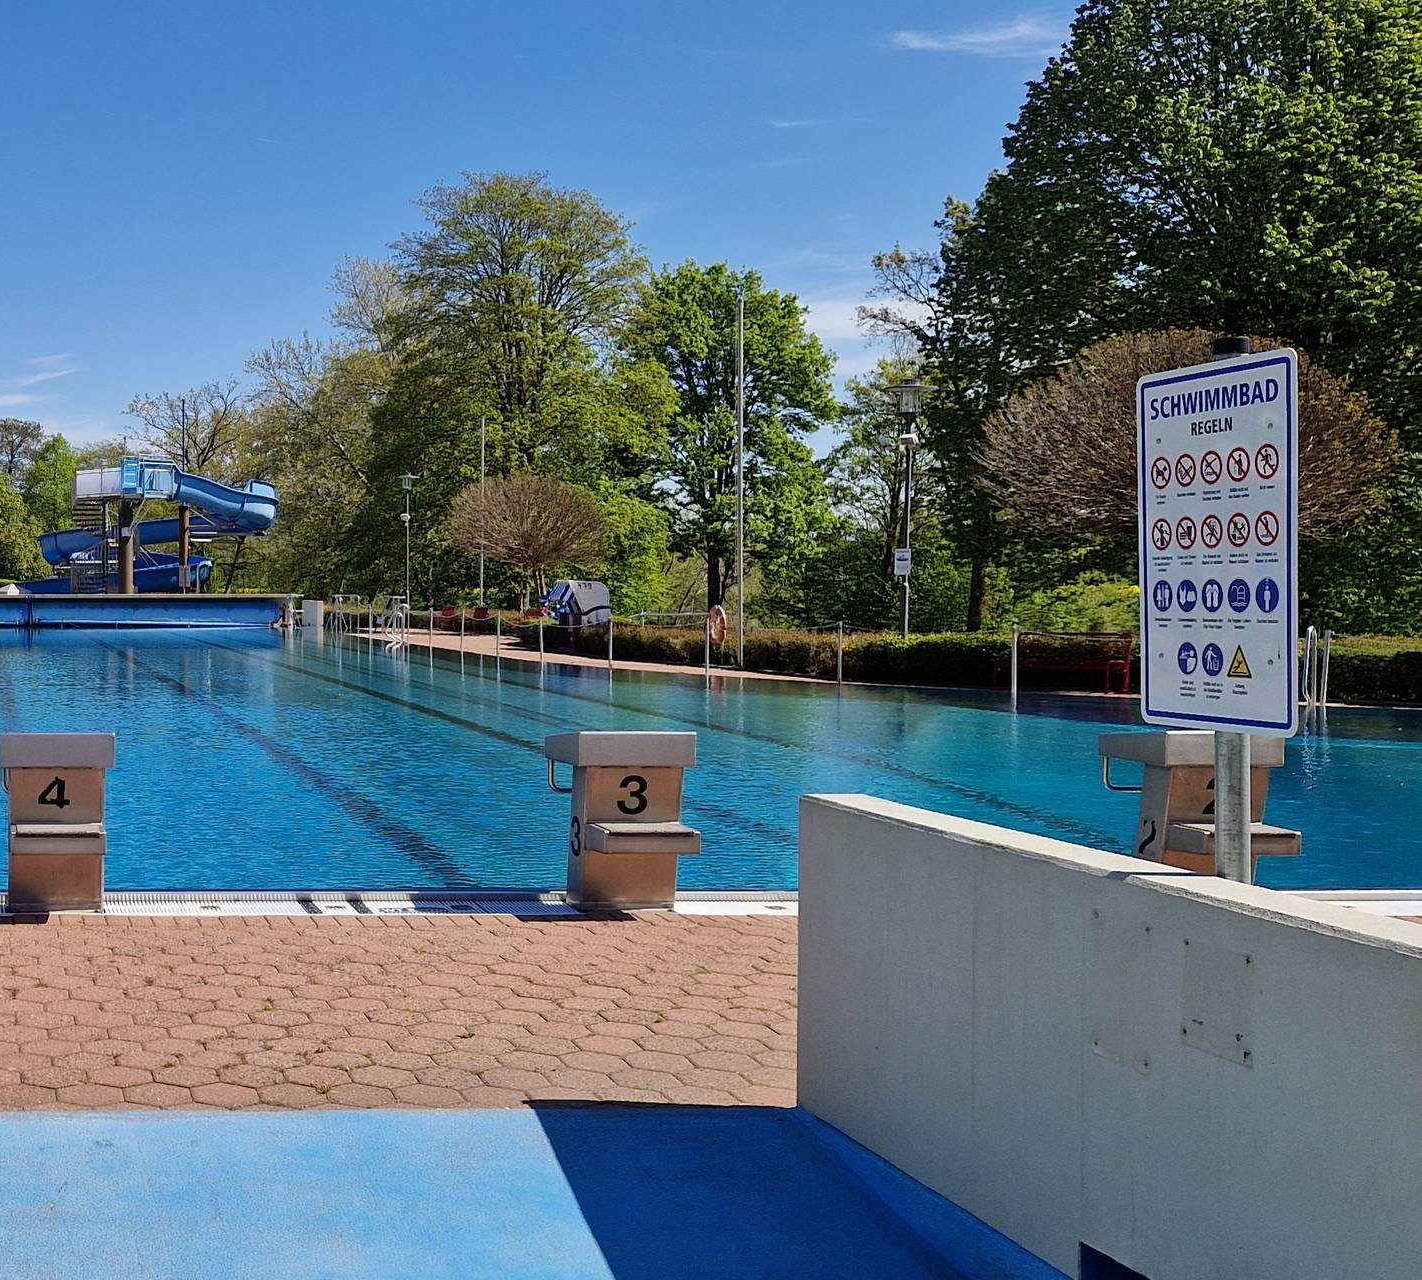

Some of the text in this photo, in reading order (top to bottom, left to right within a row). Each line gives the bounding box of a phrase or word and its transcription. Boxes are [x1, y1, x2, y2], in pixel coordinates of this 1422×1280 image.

[1150, 379, 1279, 420] SCHWIMMBAD
[1191, 417, 1233, 436] REGELN
[38, 776, 71, 808] 4
[617, 775, 648, 815] 3
[571, 816, 581, 857] 3
